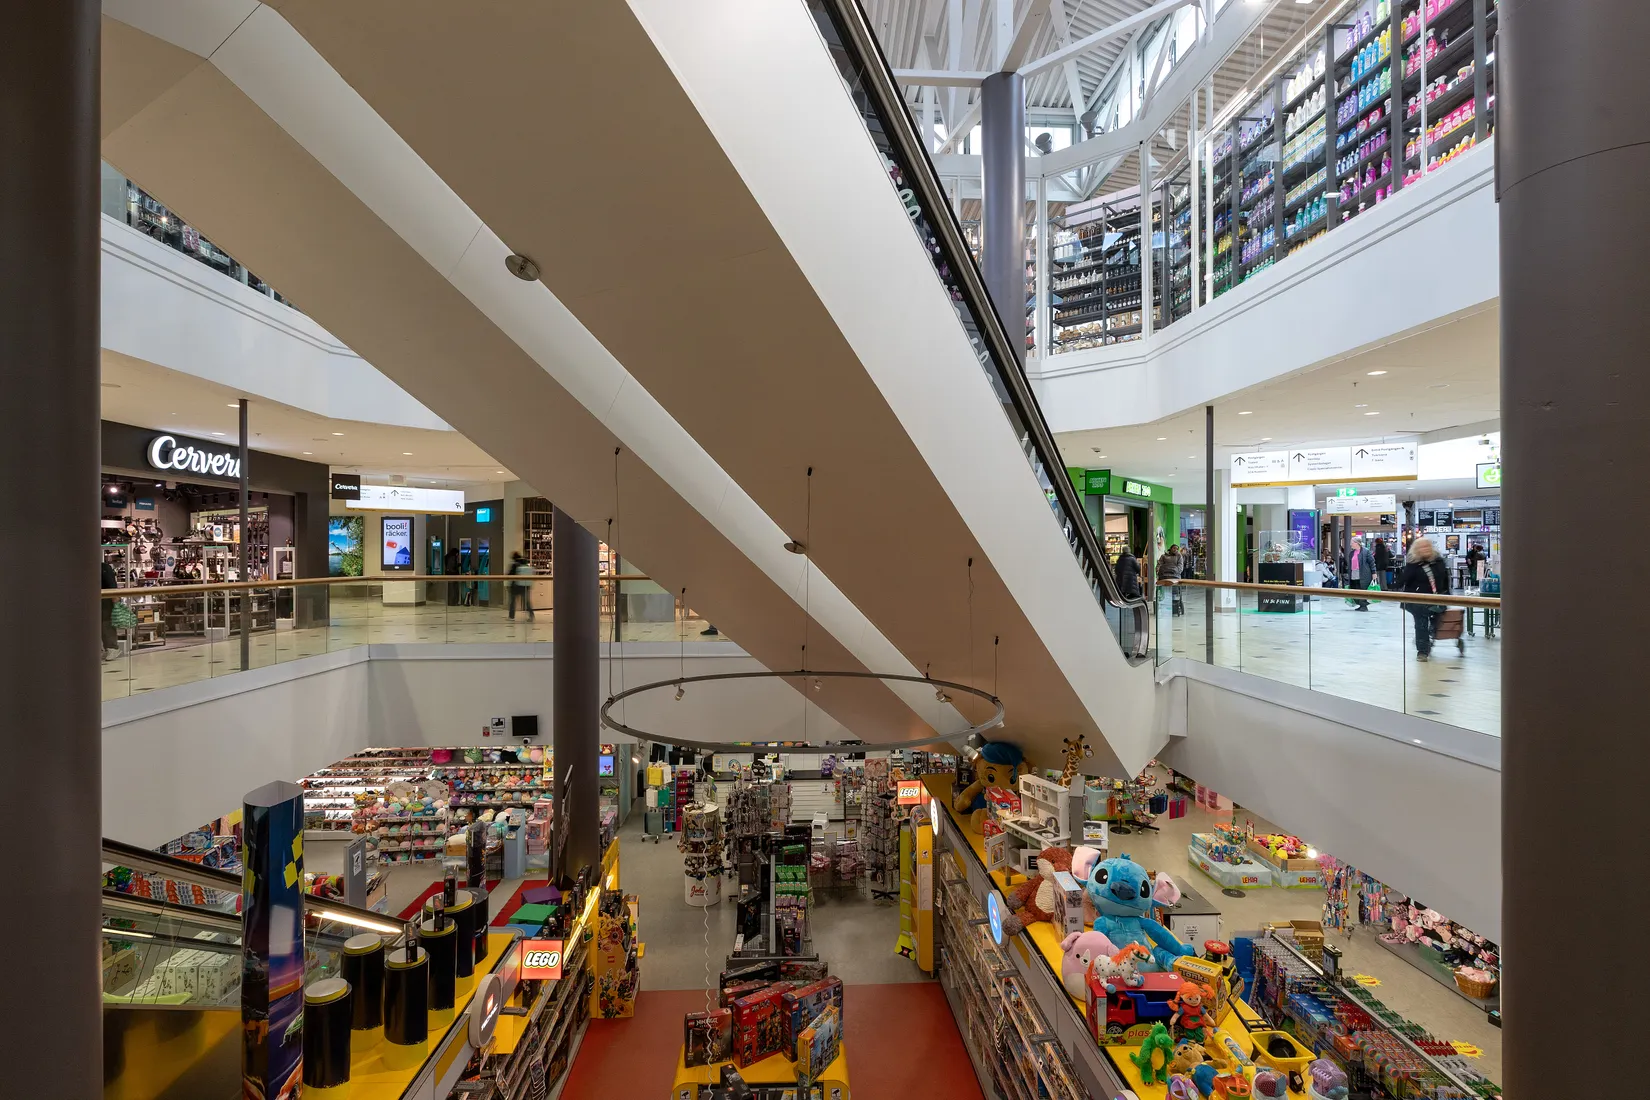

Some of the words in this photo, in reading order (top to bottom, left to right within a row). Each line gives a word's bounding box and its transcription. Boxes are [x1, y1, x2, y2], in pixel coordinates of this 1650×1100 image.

[899, 787, 919, 797] LEGO
[524, 951, 560, 967] LEGO
[1127, 1029, 1150, 1039] plas
